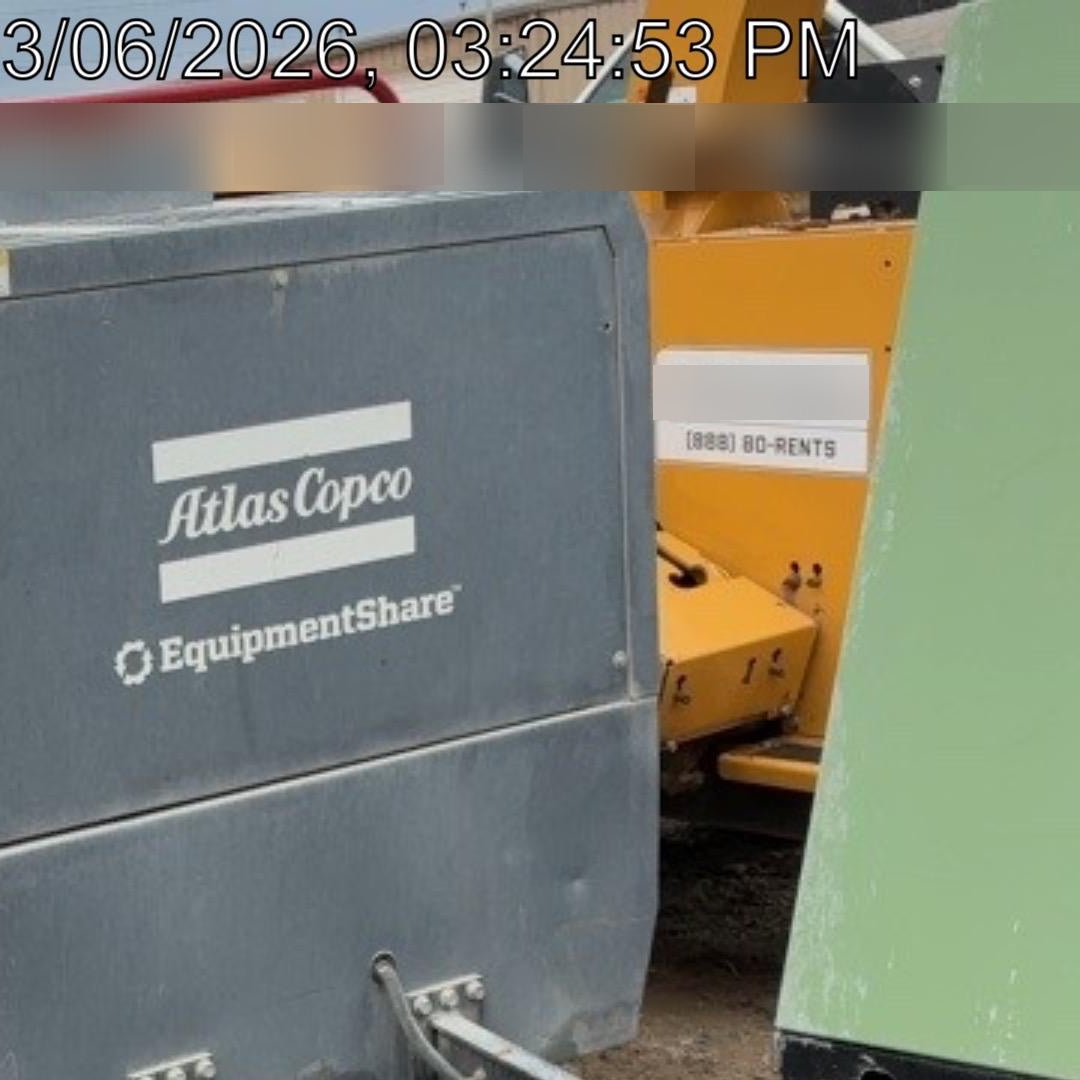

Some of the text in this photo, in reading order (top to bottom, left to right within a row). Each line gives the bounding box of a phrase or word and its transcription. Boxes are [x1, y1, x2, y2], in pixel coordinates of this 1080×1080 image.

[743, 434, 837, 459] 80-RENTS
[158, 466, 413, 545] Atlas Copco
[160, 590, 455, 674] EquipmentShare
